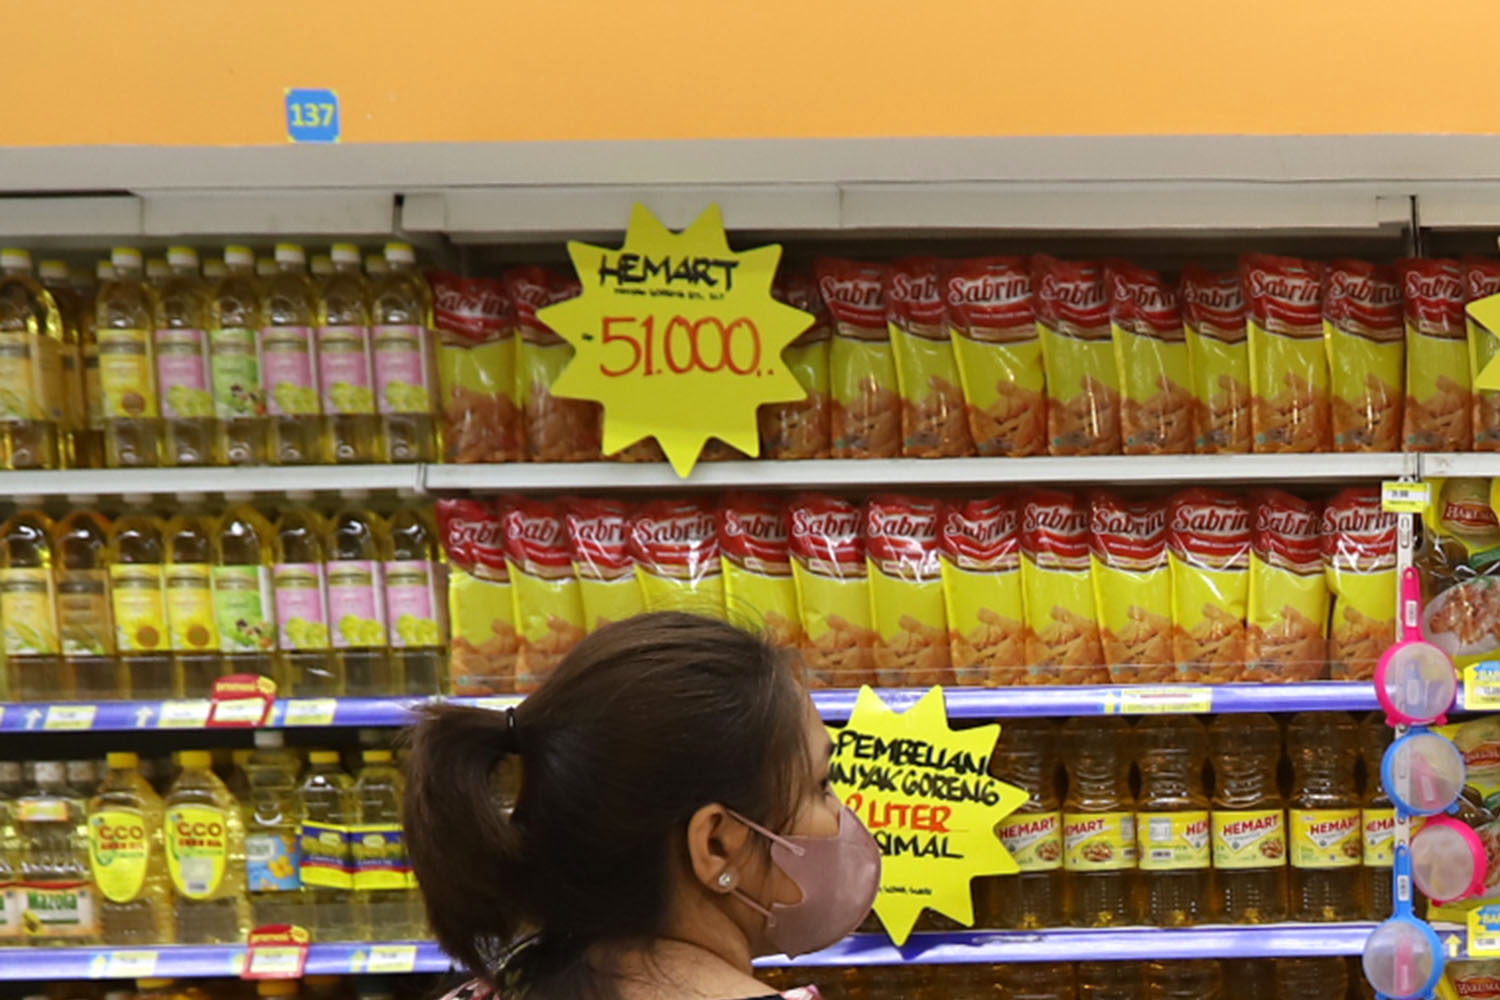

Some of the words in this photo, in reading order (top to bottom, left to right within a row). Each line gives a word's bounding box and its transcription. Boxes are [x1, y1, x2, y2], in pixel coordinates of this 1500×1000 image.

[290, 103, 334, 127] 137
[598, 254, 740, 291] HEMART
[902, 769, 1000, 807] GORENG
[867, 802, 953, 833] LITER
[1000, 815, 1056, 840] HEMART
[1223, 815, 1278, 838] HEMART
